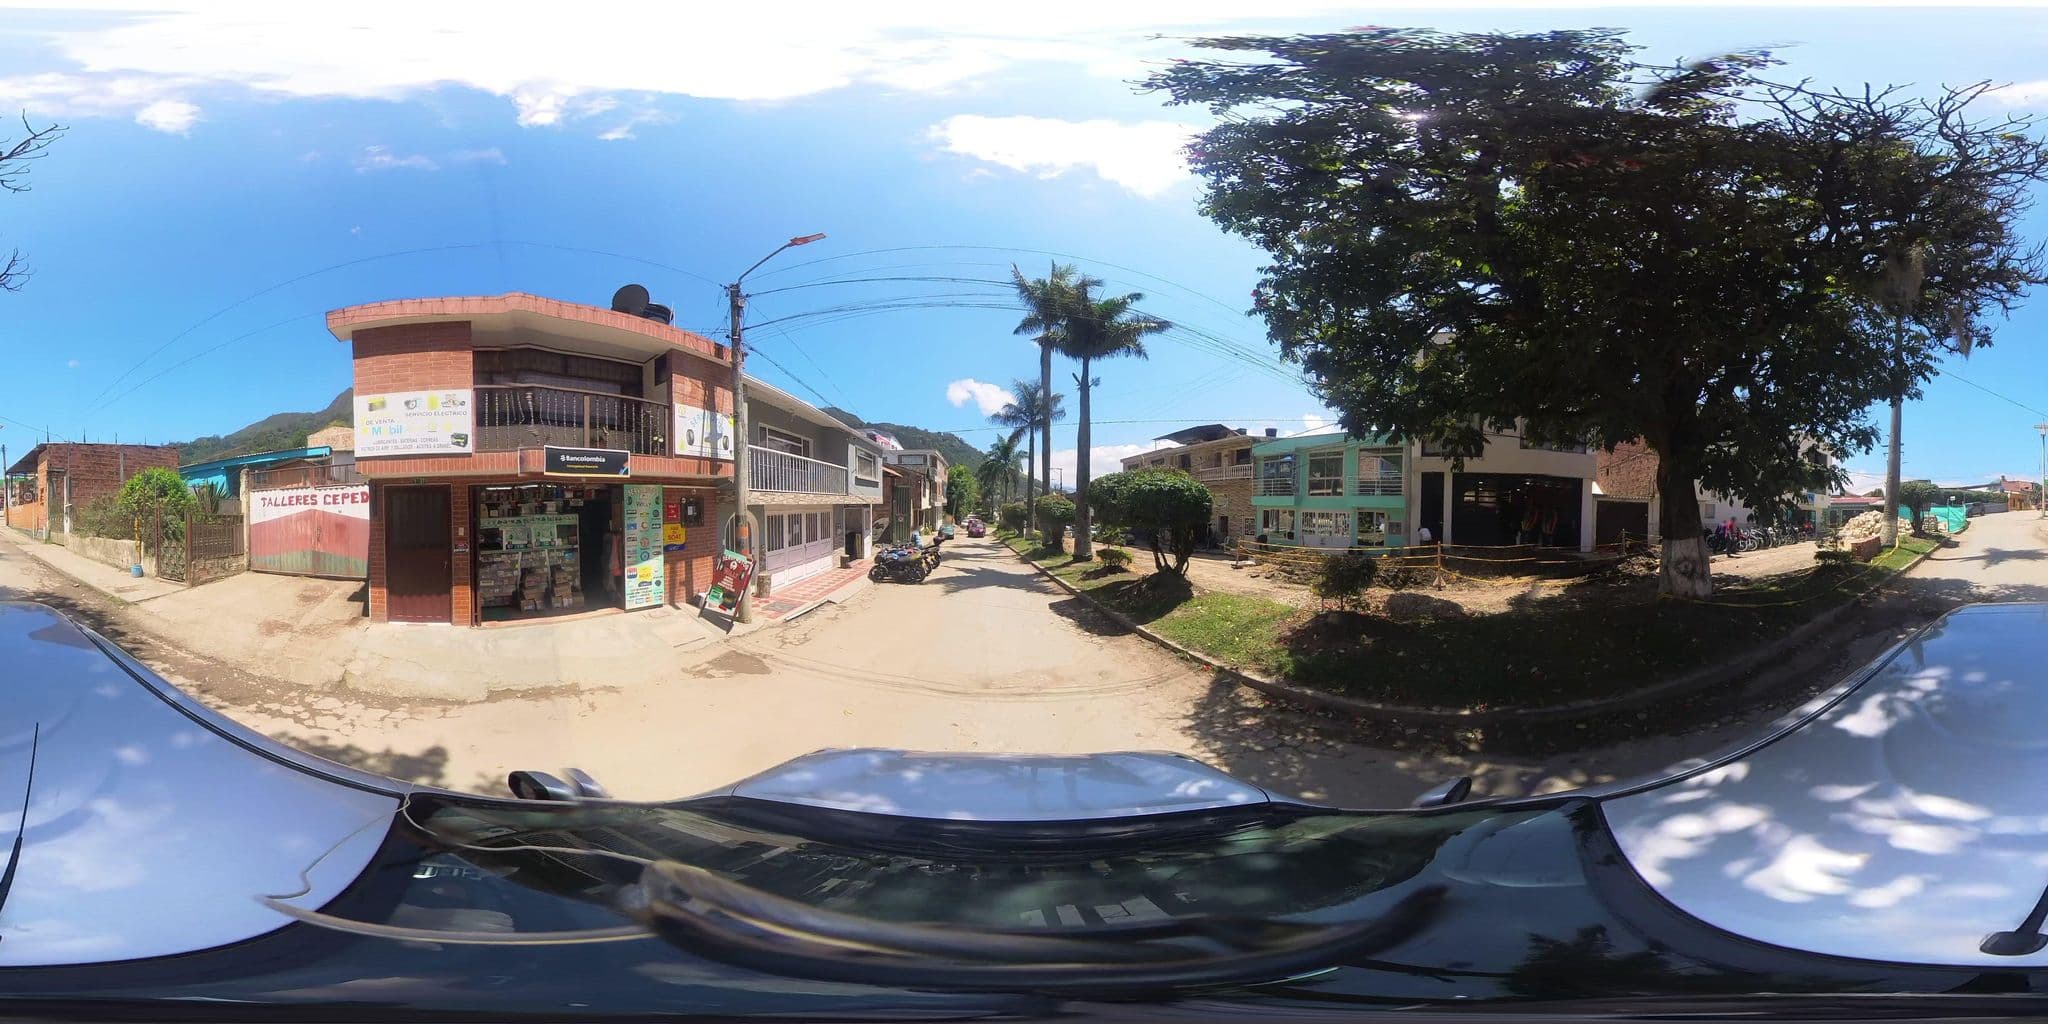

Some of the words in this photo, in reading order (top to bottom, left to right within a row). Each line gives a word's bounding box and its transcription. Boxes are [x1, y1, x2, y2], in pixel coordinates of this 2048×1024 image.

[566, 454, 606, 463] Bancolombia
[261, 494, 318, 507] TALLERES
[323, 491, 369, 505] CEPED
